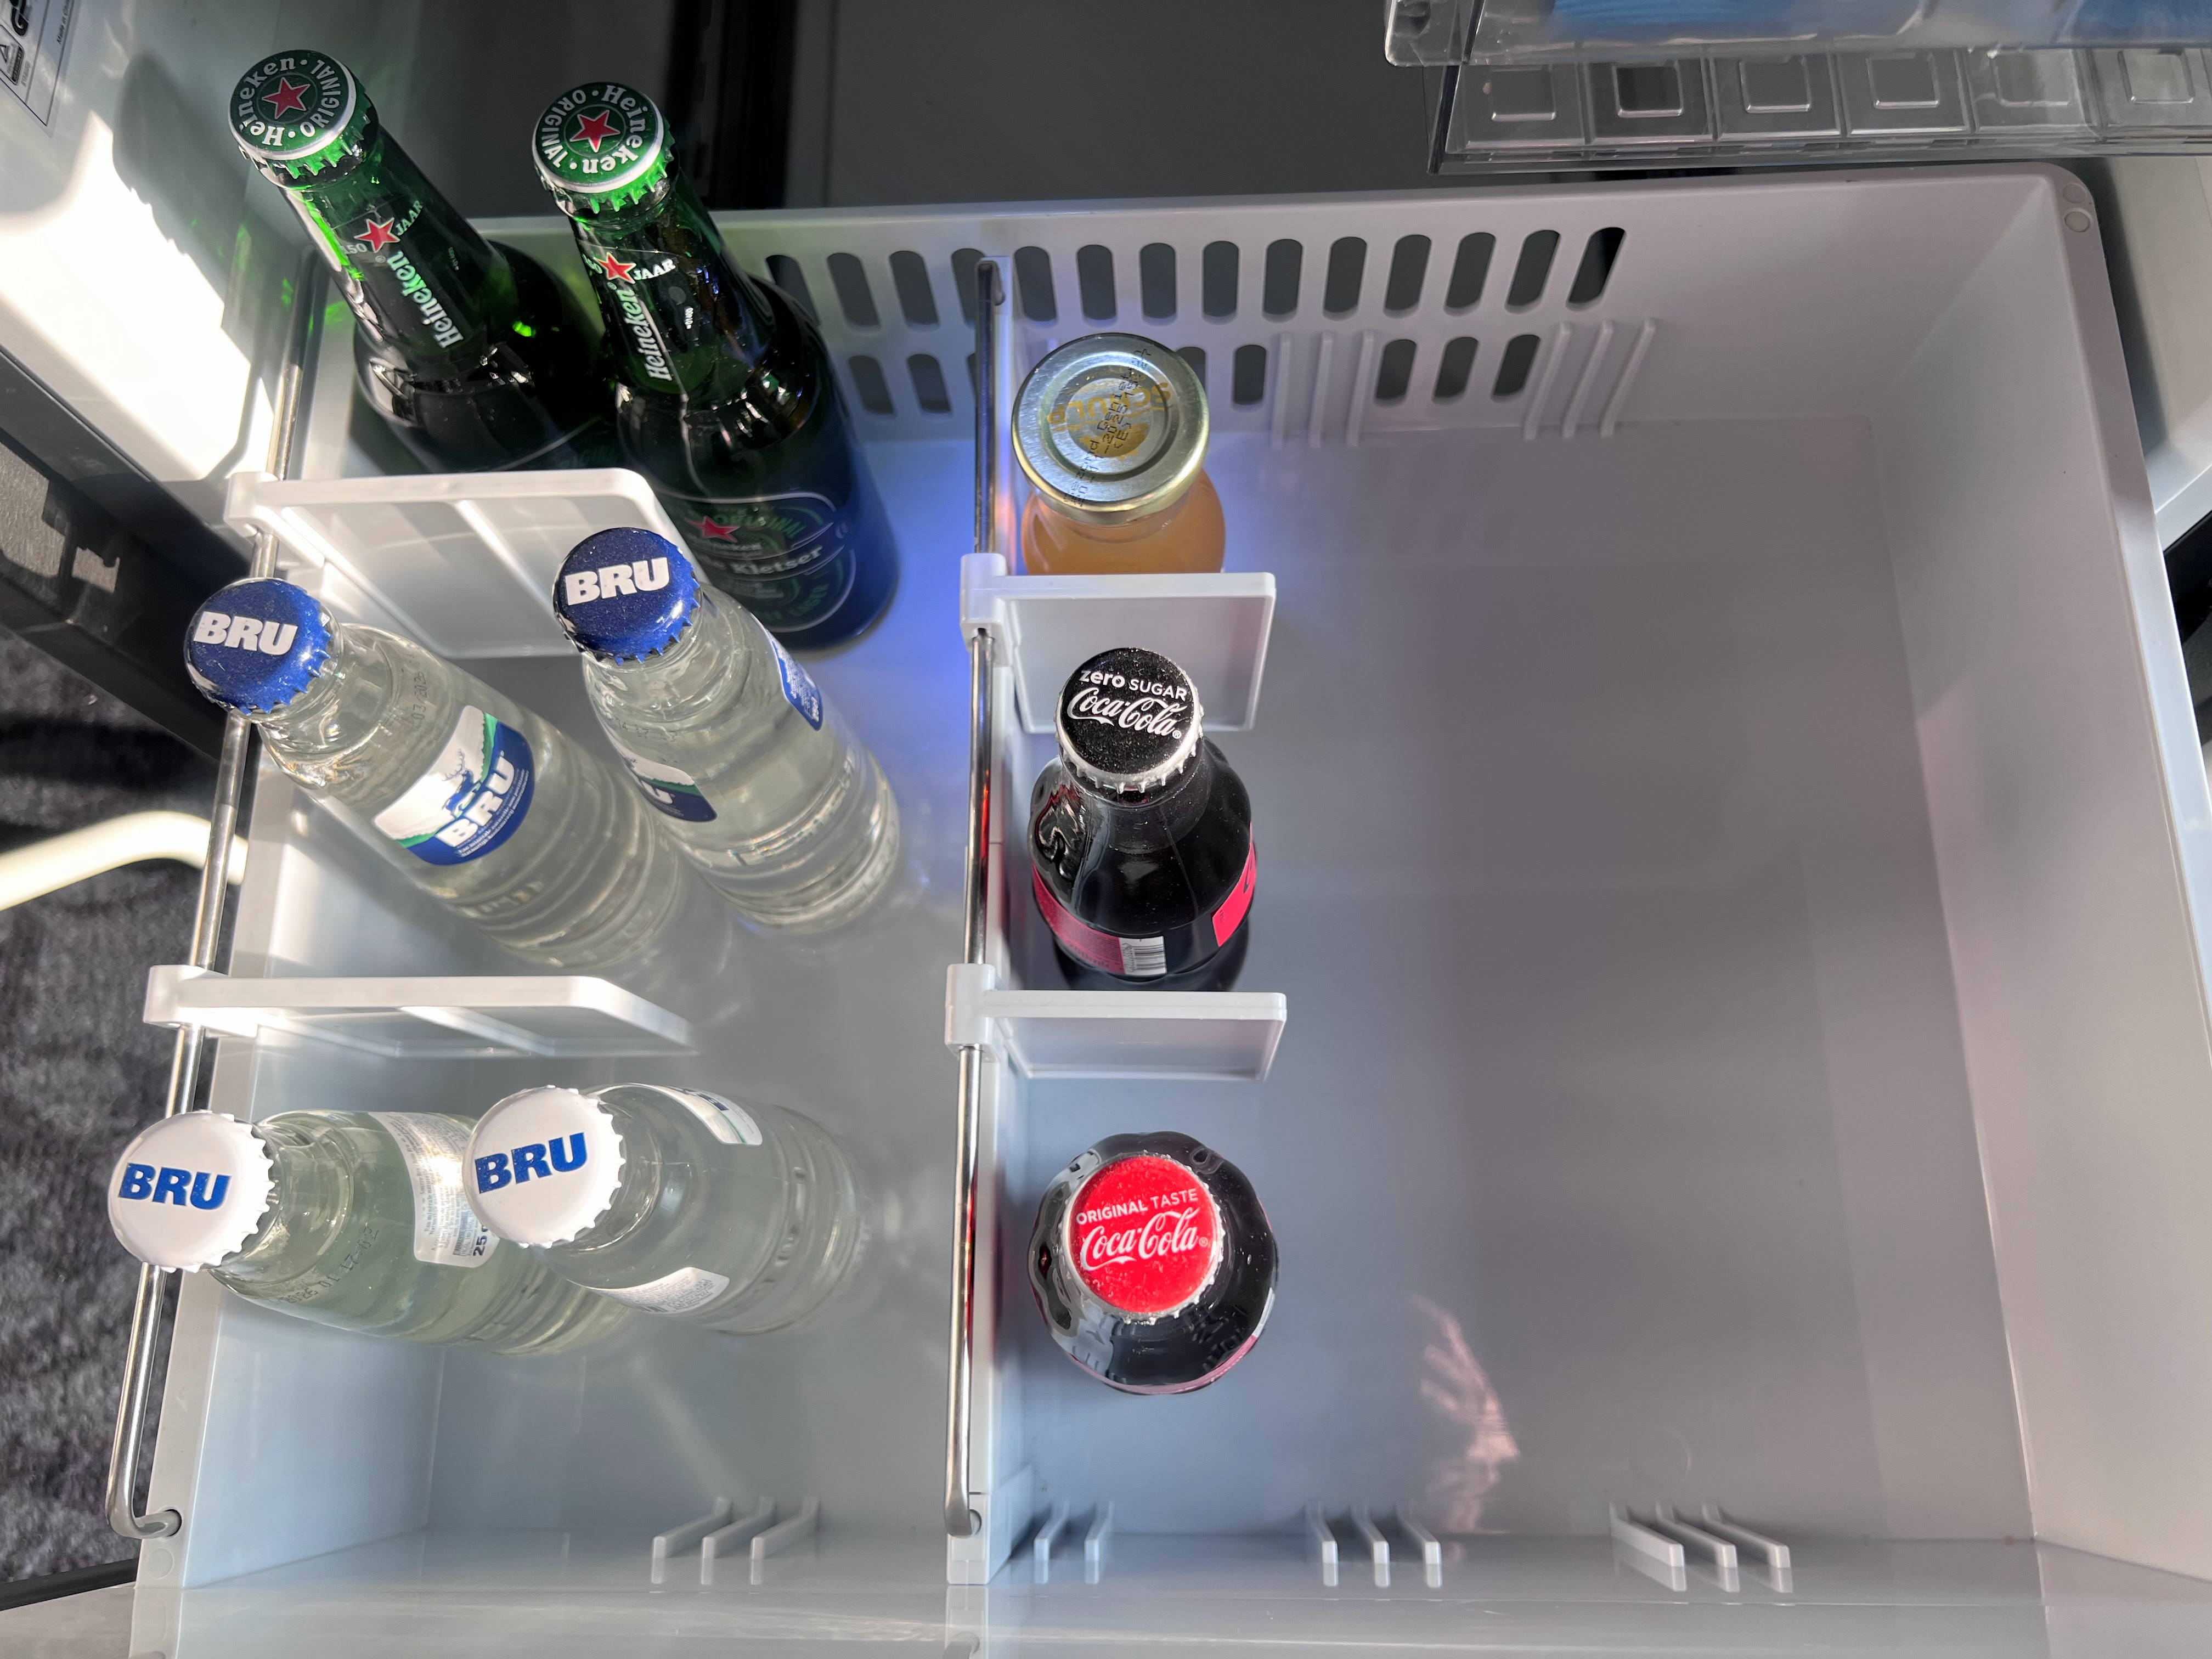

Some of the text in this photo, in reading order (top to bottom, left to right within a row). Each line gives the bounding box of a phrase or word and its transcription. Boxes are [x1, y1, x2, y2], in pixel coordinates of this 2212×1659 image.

[238, 57, 297, 146] Heineken
[300, 59, 341, 138] ORIGINAL
[540, 89, 587, 168] ORIGINAL
[582, 84, 649, 174] Heineken
[397, 200, 424, 236] JAAR
[633, 258, 676, 281] JAAR
[386, 250, 465, 349] Heineken
[616, 289, 673, 381] Heineken
[565, 557, 670, 606] BRU
[193, 611, 298, 655] BRU
[1067, 687, 1187, 736] Coca-Cola
[1079, 670, 1187, 701] zero SUGAR
[435, 756, 515, 848] BRU
[119, 1163, 232, 1210] BRU
[475, 1132, 588, 1194] BRU
[1076, 1188, 1198, 1225] ORIGINAL TASTE
[473, 1235, 488, 1256] 25
[1080, 1207, 1198, 1271] Coca-Cola
